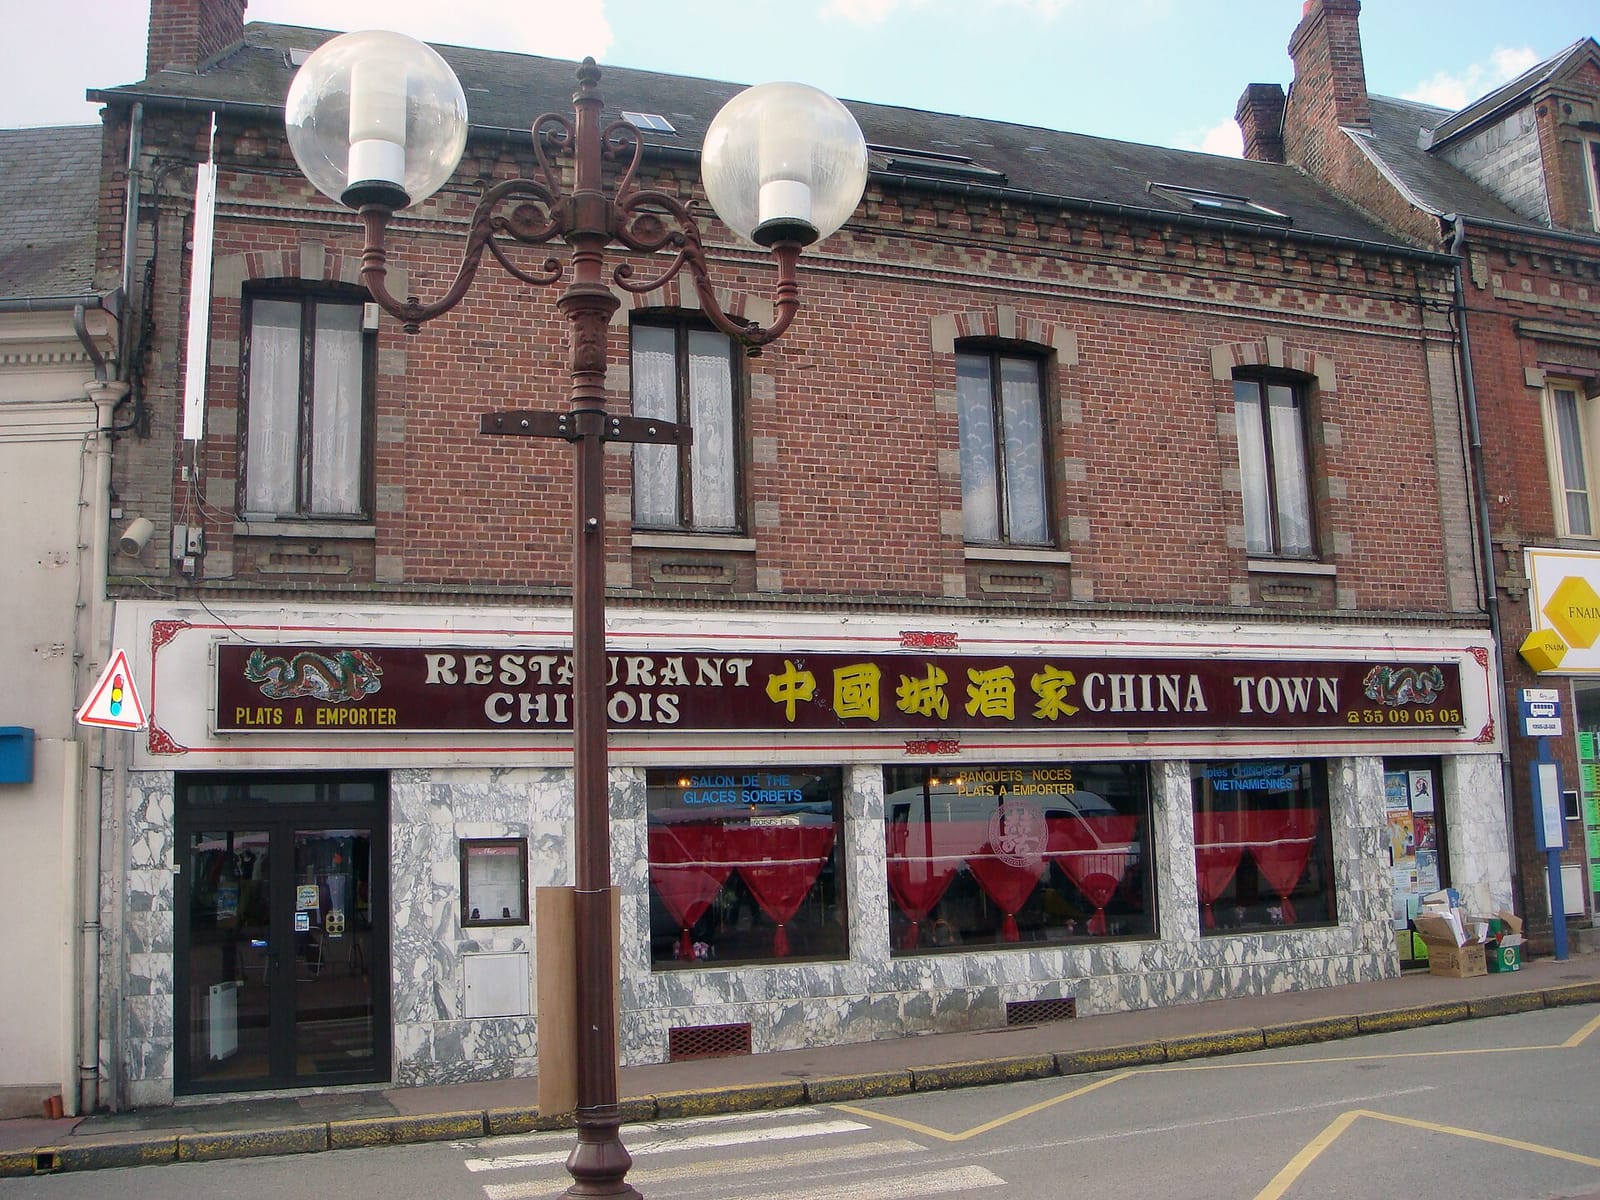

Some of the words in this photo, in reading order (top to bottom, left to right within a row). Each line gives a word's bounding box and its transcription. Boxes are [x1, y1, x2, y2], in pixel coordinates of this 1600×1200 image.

[1545, 643, 1564, 652] FNAIM
[766, 659, 1080, 721] 中國城酒家
[1082, 672, 1208, 712] CHINA
[1233, 676, 1339, 714] TOWN
[484, 691, 680, 724] CHIOIS
[236, 707, 282, 725] PLATS
[295, 708, 304, 725] A
[316, 707, 397, 725] EMPORTER
[1363, 709, 1383, 723] 35
[1388, 709, 1409, 723] 09
[1414, 709, 1435, 723] 05
[1439, 709, 1459, 722] 05
[691, 776, 734, 788] SALON
[742, 775, 760, 787] DE
[960, 770, 1022, 782] BANQUETS
[1032, 769, 1072, 781] NOCES
[958, 784, 995, 797] PLATS
[1000, 785, 1009, 796] A
[1013, 783, 1075, 796] EMPORTER
[1213, 778, 1293, 791] VIETNAMIENNES
[683, 790, 736, 804] GLACES
[741, 789, 802, 802] SORBETS
